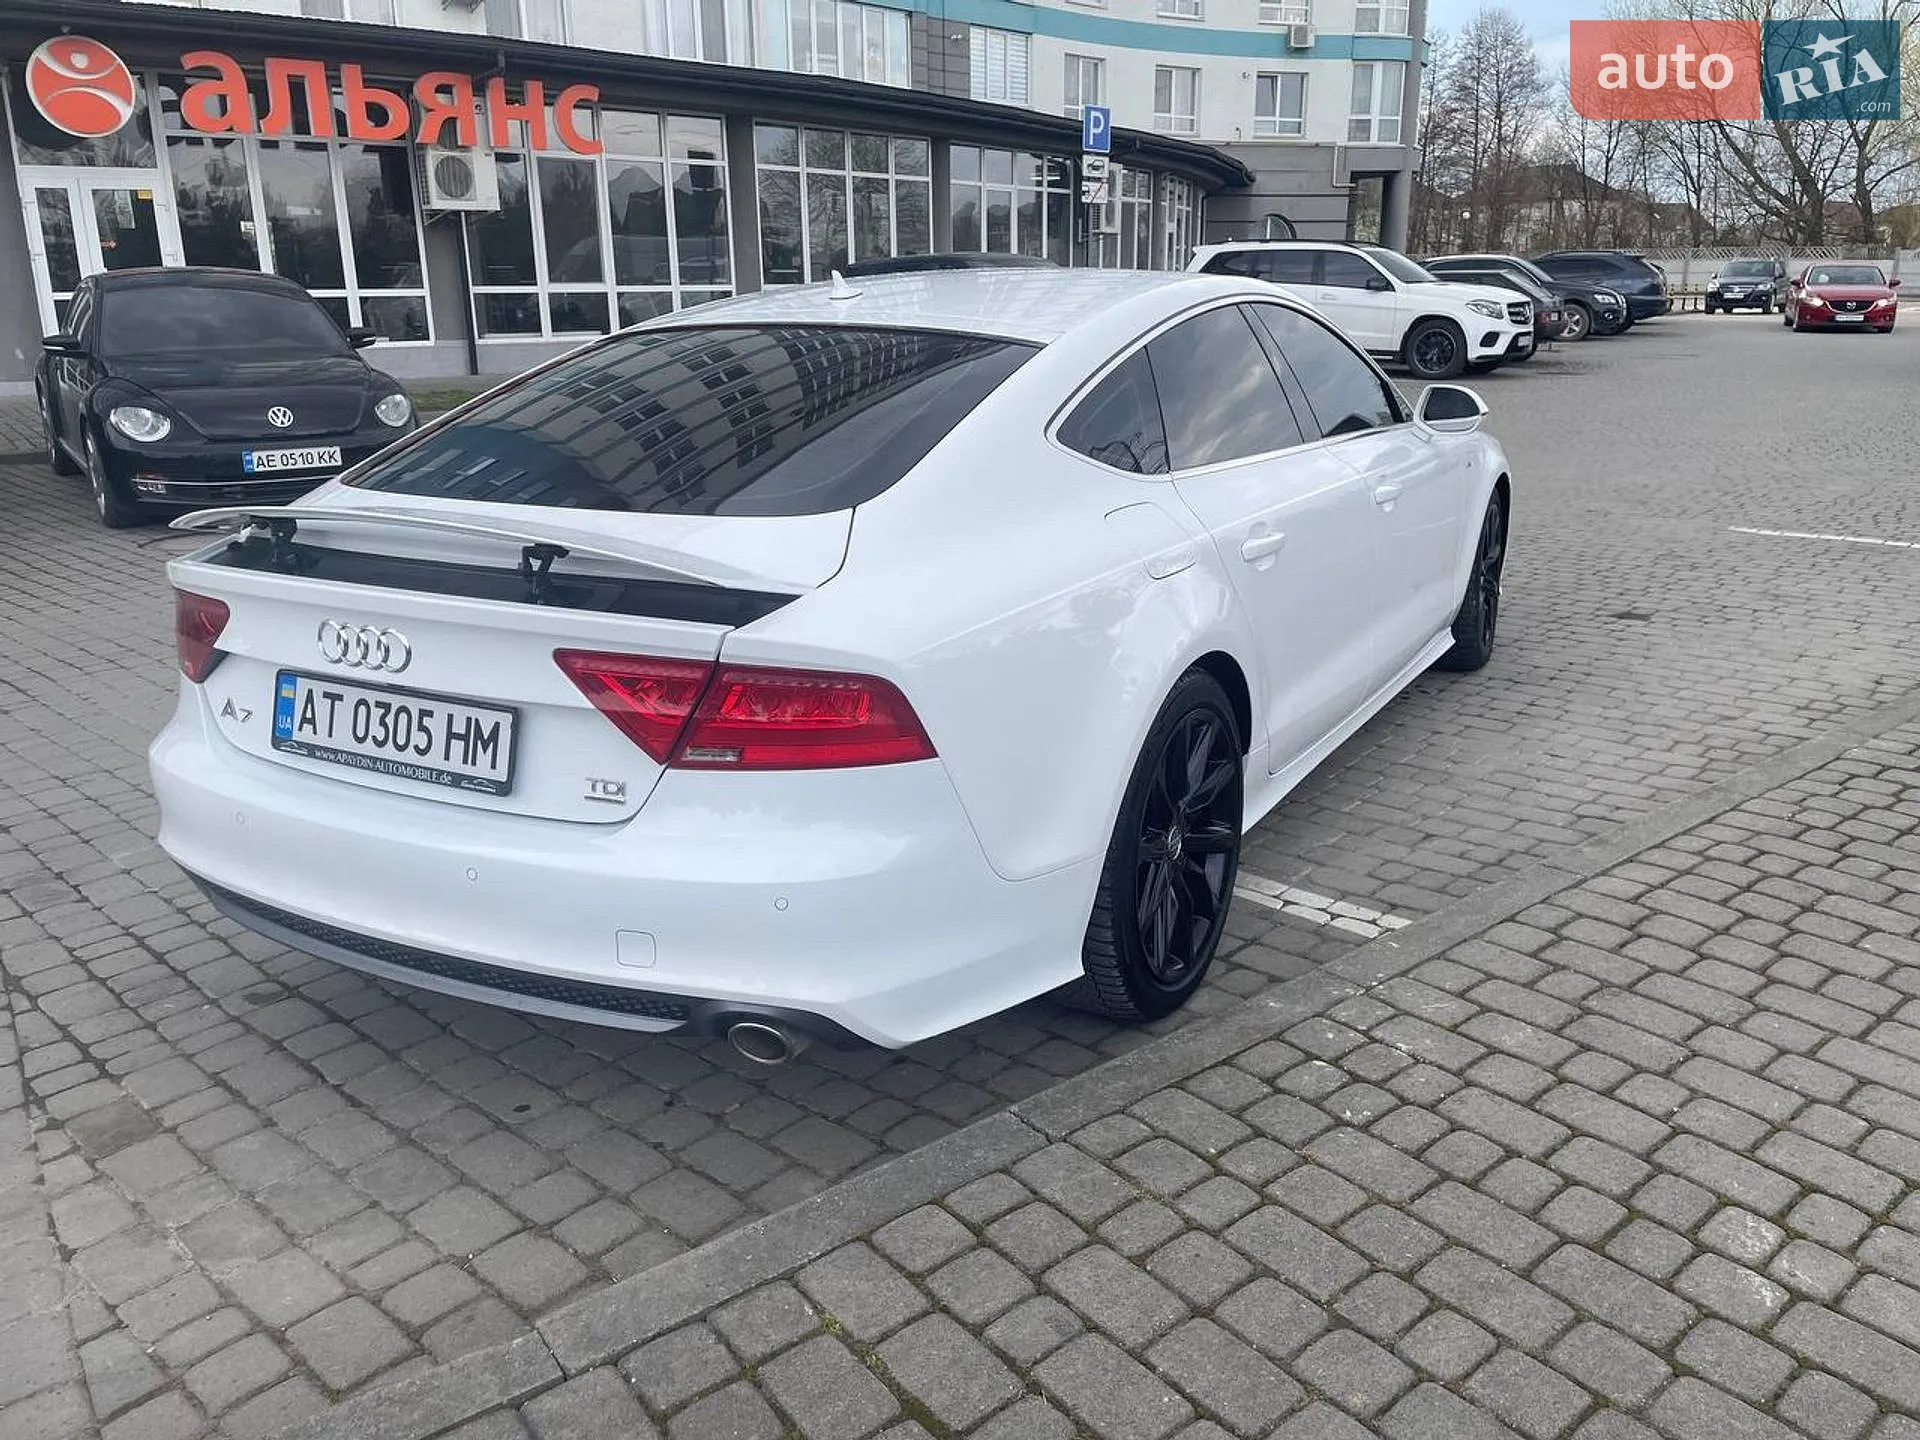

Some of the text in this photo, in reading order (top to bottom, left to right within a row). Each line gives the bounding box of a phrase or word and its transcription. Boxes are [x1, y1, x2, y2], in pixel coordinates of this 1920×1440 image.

[179, 50, 605, 155] альянс
[1089, 111, 1104, 145] P
[256, 449, 339, 469] AE 0510 KK
[220, 698, 254, 723] A7
[278, 714, 293, 731] UA
[298, 688, 501, 771] AT 0305 HM
